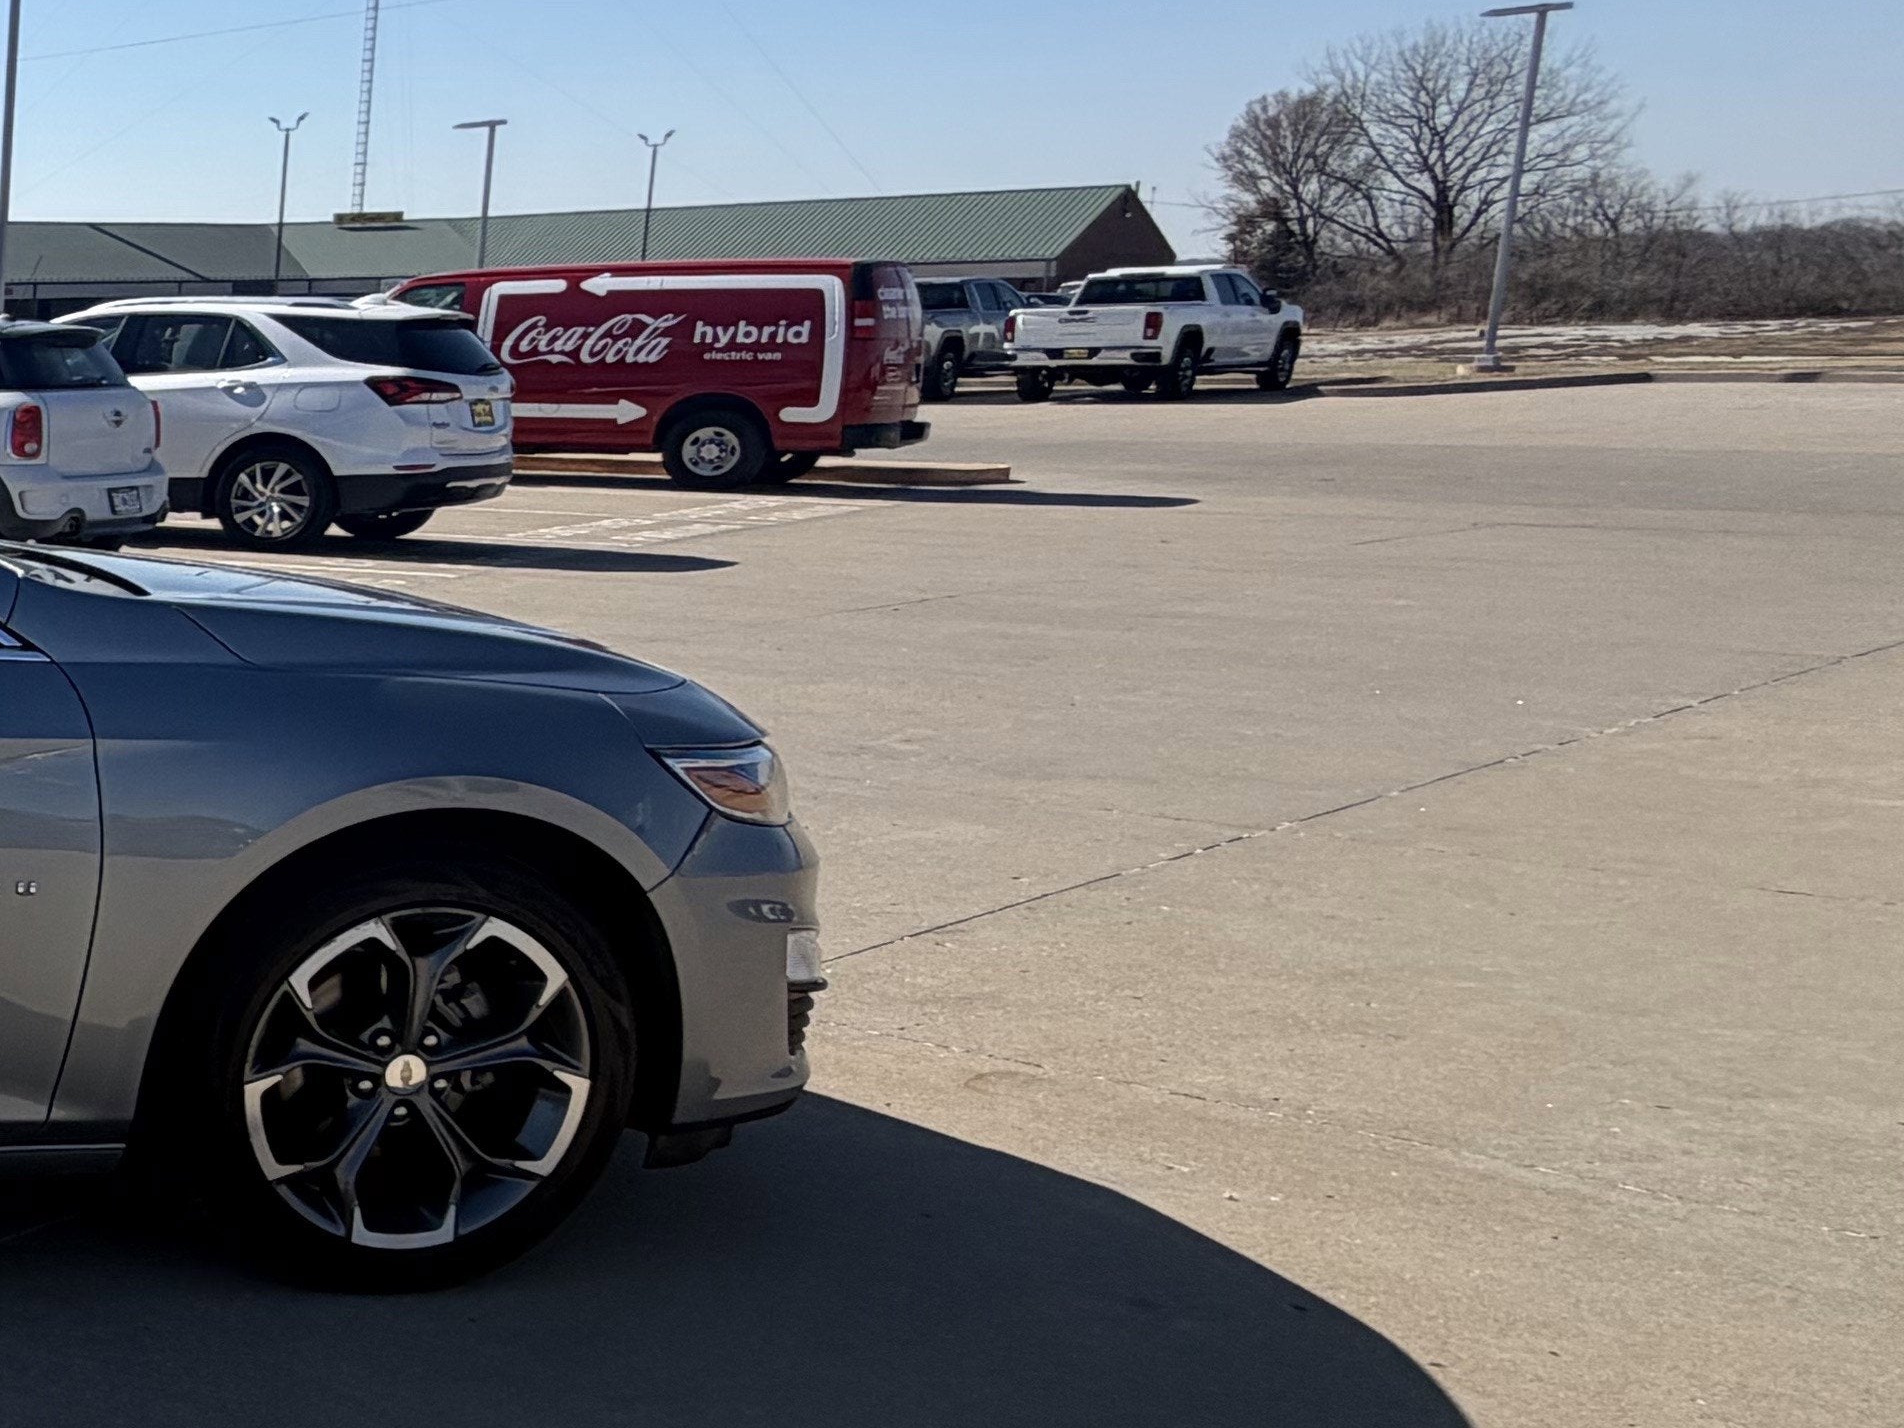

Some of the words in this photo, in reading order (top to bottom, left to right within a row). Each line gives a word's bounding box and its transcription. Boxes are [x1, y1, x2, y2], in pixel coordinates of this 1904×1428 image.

[500, 313, 688, 364] Coca-Cola
[692, 319, 812, 348] hybrid
[703, 350, 754, 361] electric
[756, 351, 782, 361] van
